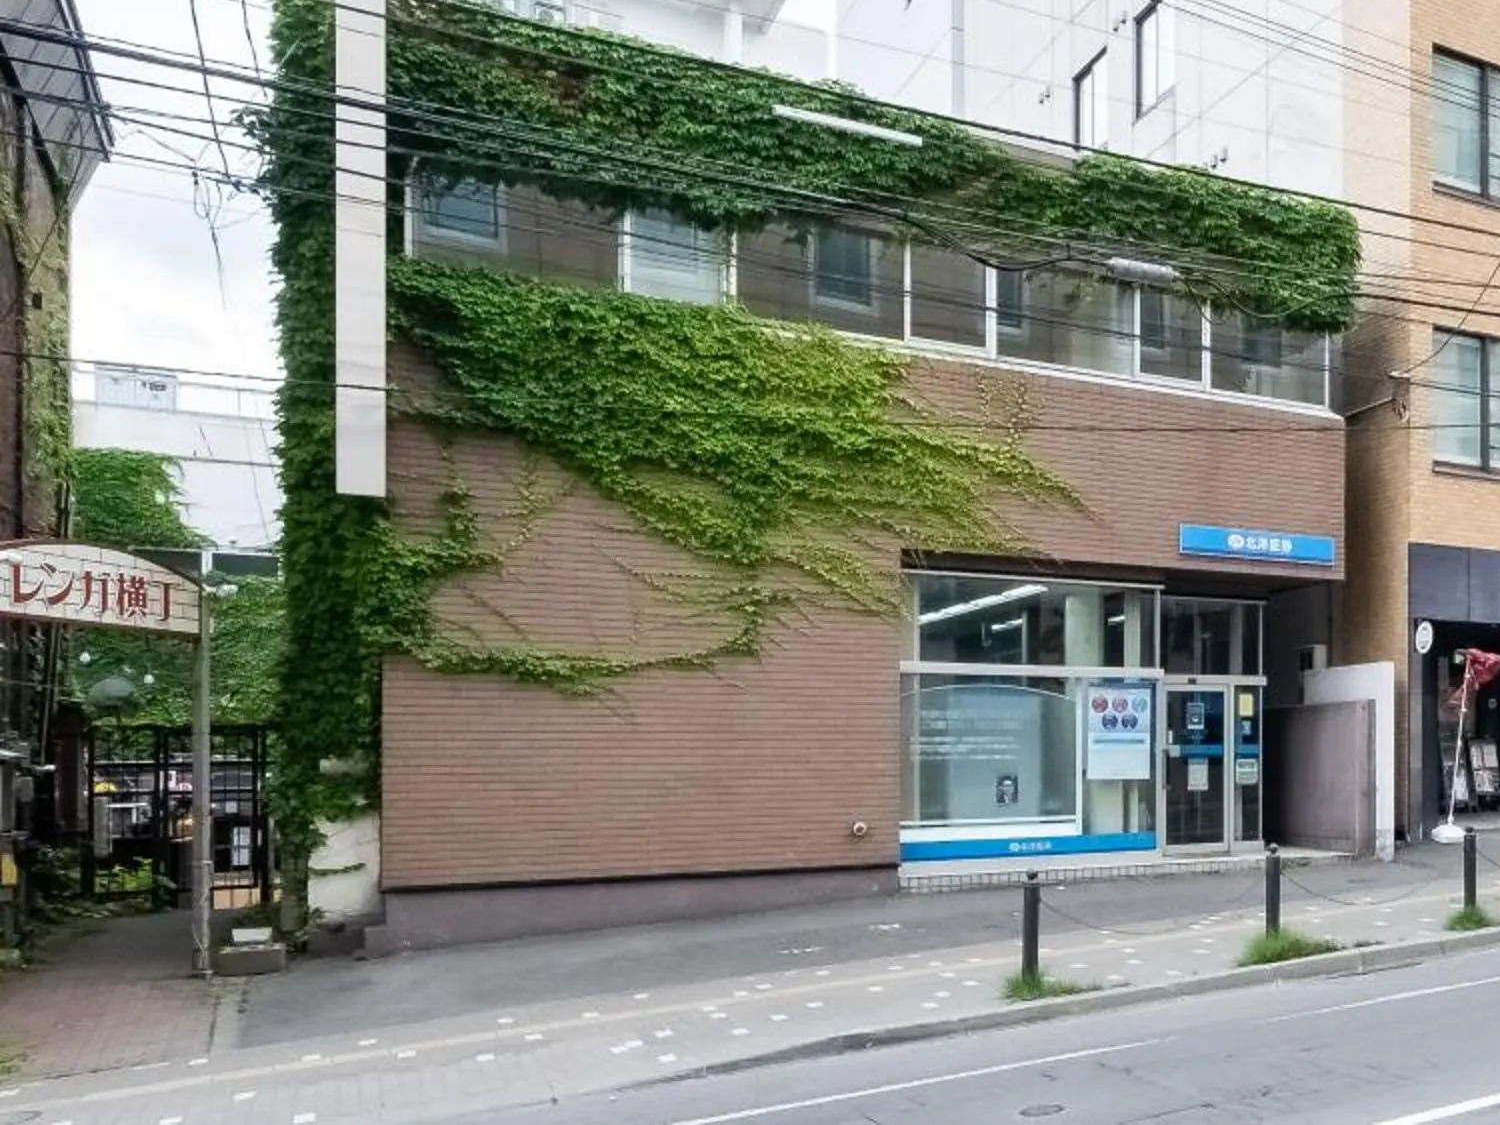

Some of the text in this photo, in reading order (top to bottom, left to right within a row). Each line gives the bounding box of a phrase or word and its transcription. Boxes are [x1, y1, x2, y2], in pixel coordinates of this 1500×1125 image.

[12, 561, 180, 621] レンガ横丁
